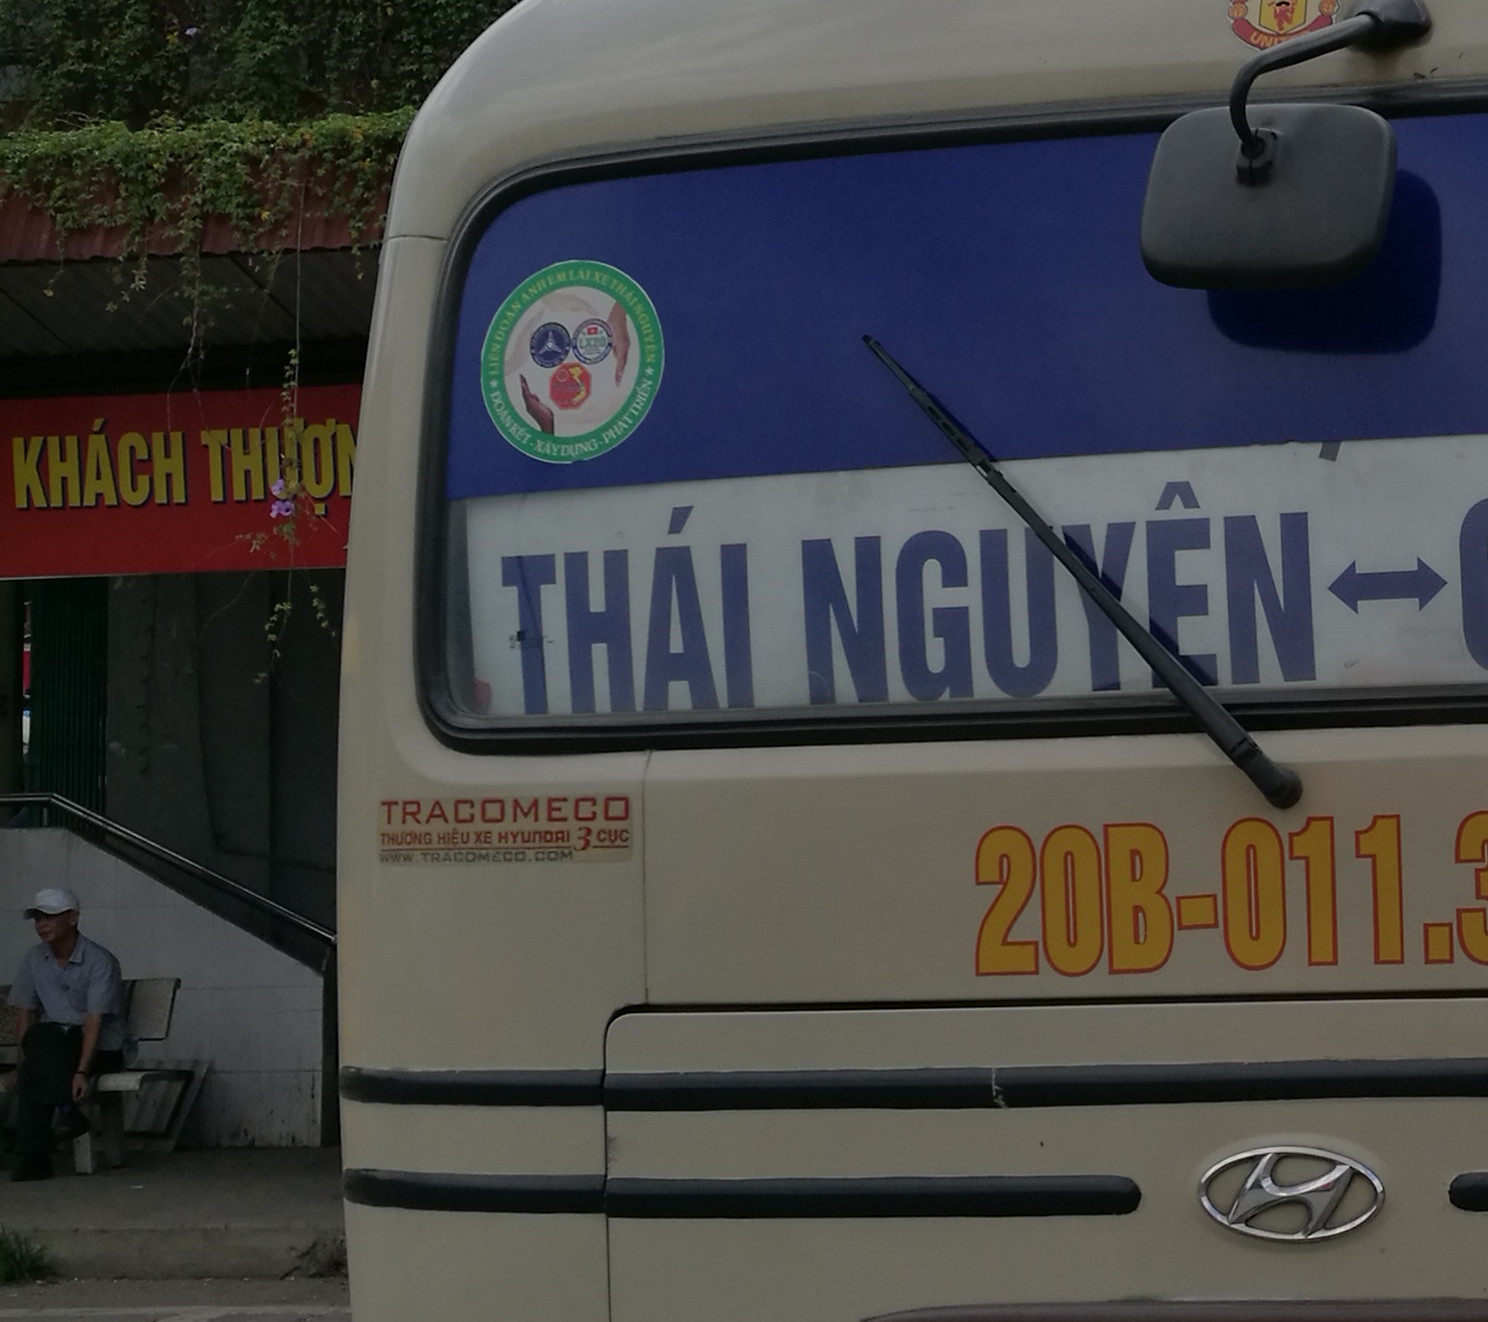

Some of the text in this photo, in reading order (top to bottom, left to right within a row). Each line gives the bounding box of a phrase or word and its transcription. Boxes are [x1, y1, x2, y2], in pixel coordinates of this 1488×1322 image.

[12, 418, 188, 509] KHÁCH
[501, 505, 755, 715] THÁI
[801, 481, 1316, 703] NGUYÊN
[380, 795, 630, 824] TRACOMECO
[475, 830, 492, 844] XE
[497, 829, 571, 845] HYUNDAI
[573, 826, 592, 852] 3
[597, 828, 630, 846] CỤC
[379, 849, 574, 864] WWW.TRACOMECO.COM
